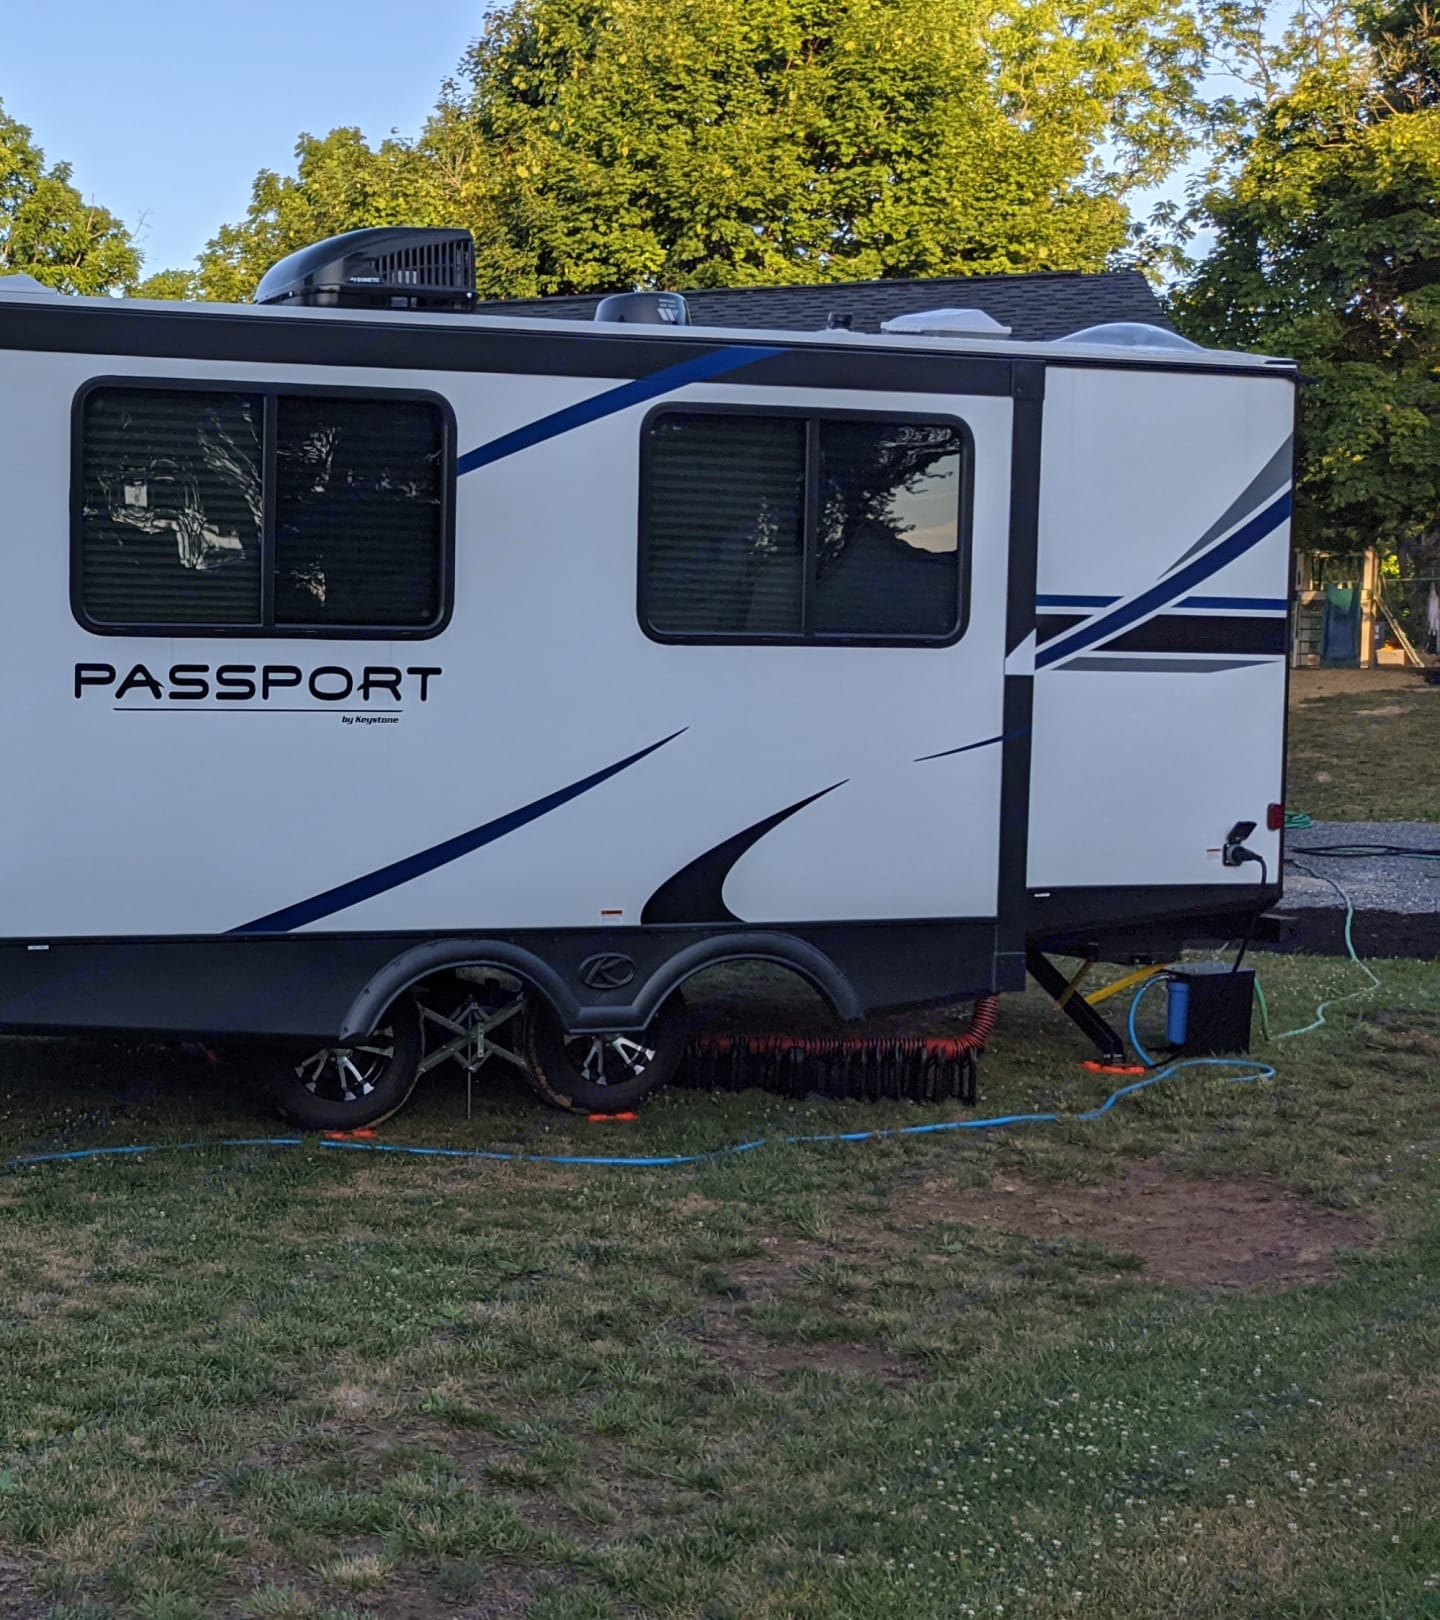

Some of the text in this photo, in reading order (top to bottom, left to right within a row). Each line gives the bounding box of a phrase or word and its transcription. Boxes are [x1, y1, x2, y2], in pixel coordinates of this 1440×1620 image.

[75, 663, 442, 701] PASSPORT
[341, 716, 399, 725] by Keystone
